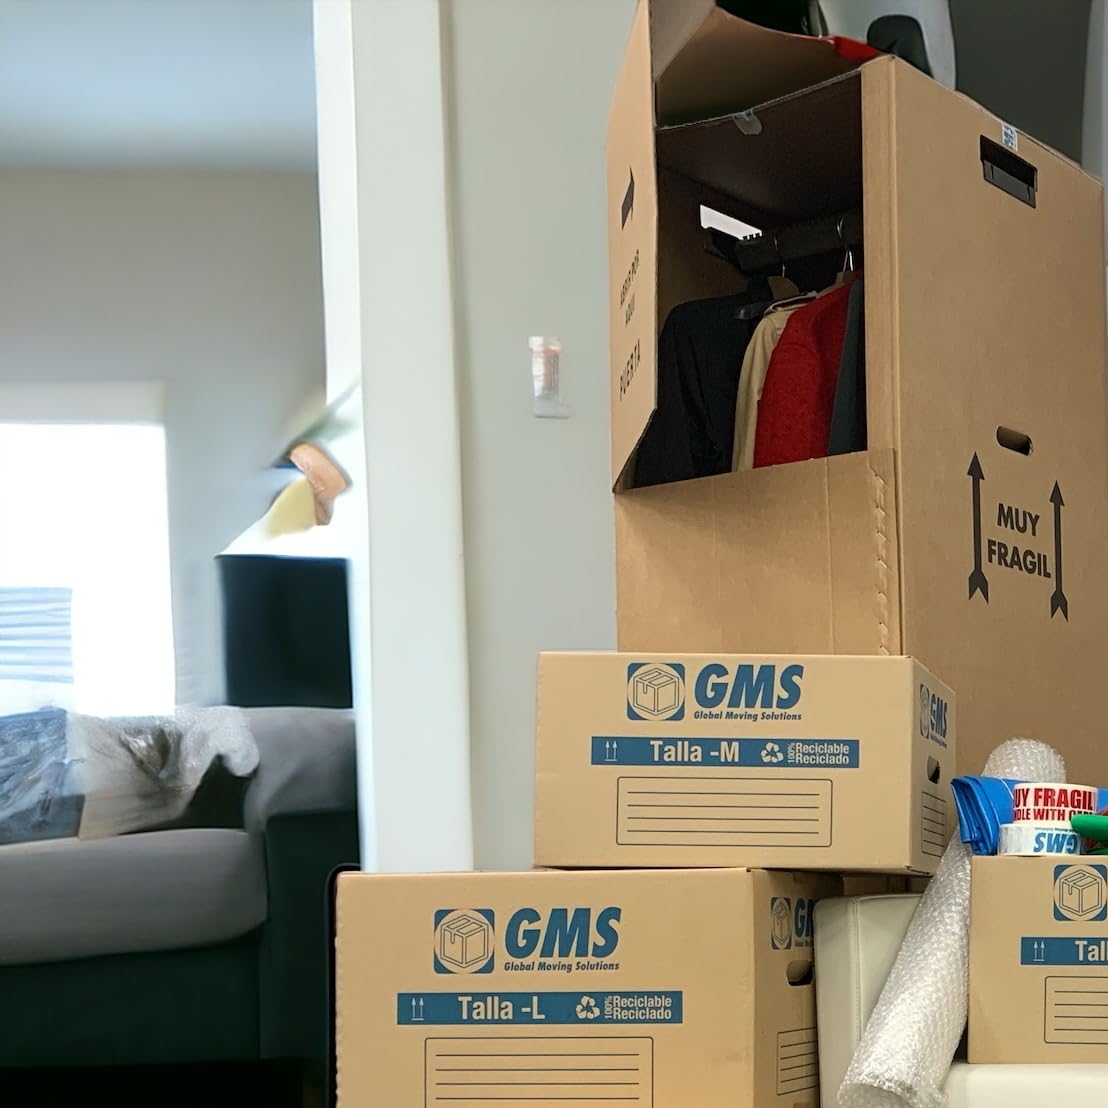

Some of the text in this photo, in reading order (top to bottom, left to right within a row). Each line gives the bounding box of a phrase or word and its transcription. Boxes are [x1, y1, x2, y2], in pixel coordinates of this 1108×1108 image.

[620, 338, 640, 401] PUERTA
[997, 503, 1040, 536] MUY
[987, 539, 1051, 578] FRAGIL
[694, 663, 804, 709] GMS
[694, 711, 802, 722] Global Moving Solutions
[931, 693, 948, 738] GMS
[650, 740, 740, 763] Talla -M
[787, 742, 796, 763] 100%
[795, 742, 850, 754] Reciclable
[795, 753, 850, 765] Reciclado
[1014, 787, 1093, 811] UY FRAGIL
[1033, 809, 1066, 822] WITH
[505, 906, 622, 960] GMS
[504, 961, 620, 973] Global Moving Solutions
[458, 995, 545, 1020] Talla -L
[604, 996, 613, 1019] 100%
[612, 995, 672, 1008] Reciclable
[612, 1007, 672, 1020] Reciclado
